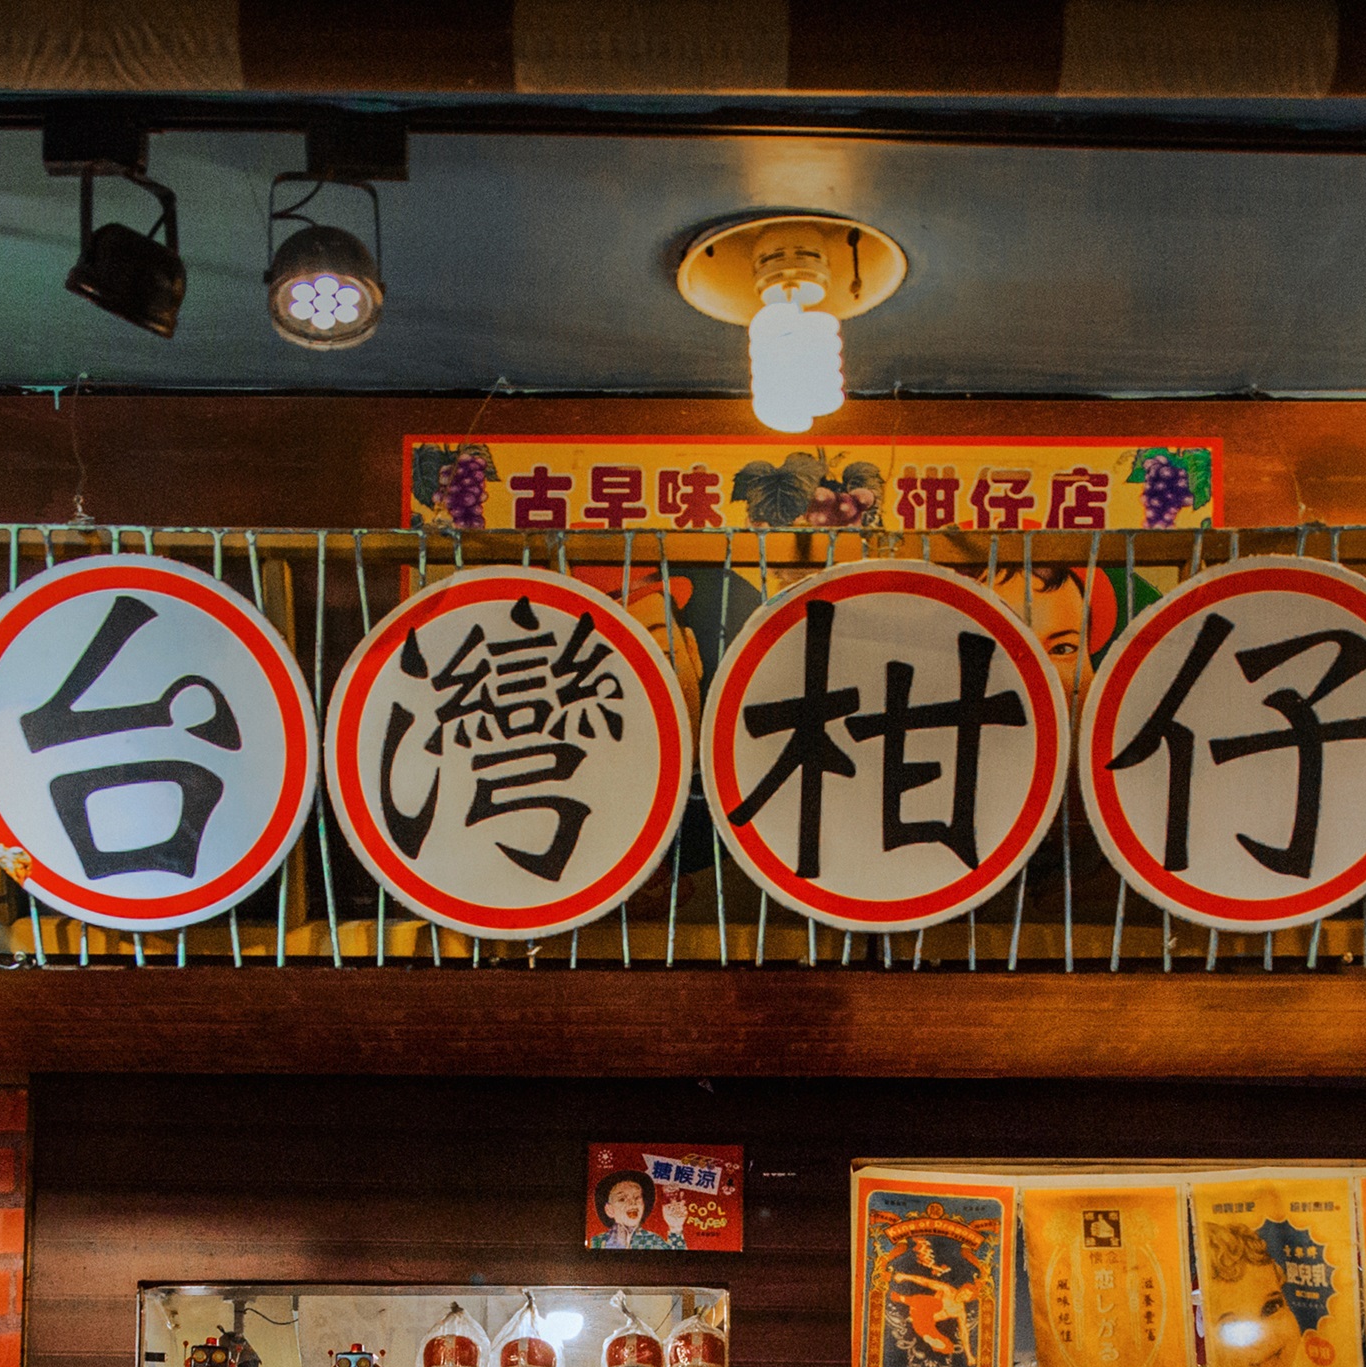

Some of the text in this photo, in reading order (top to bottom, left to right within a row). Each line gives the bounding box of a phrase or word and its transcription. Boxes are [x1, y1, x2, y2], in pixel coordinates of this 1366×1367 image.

[510, 464, 1110, 530] 古早味 柑仔店
